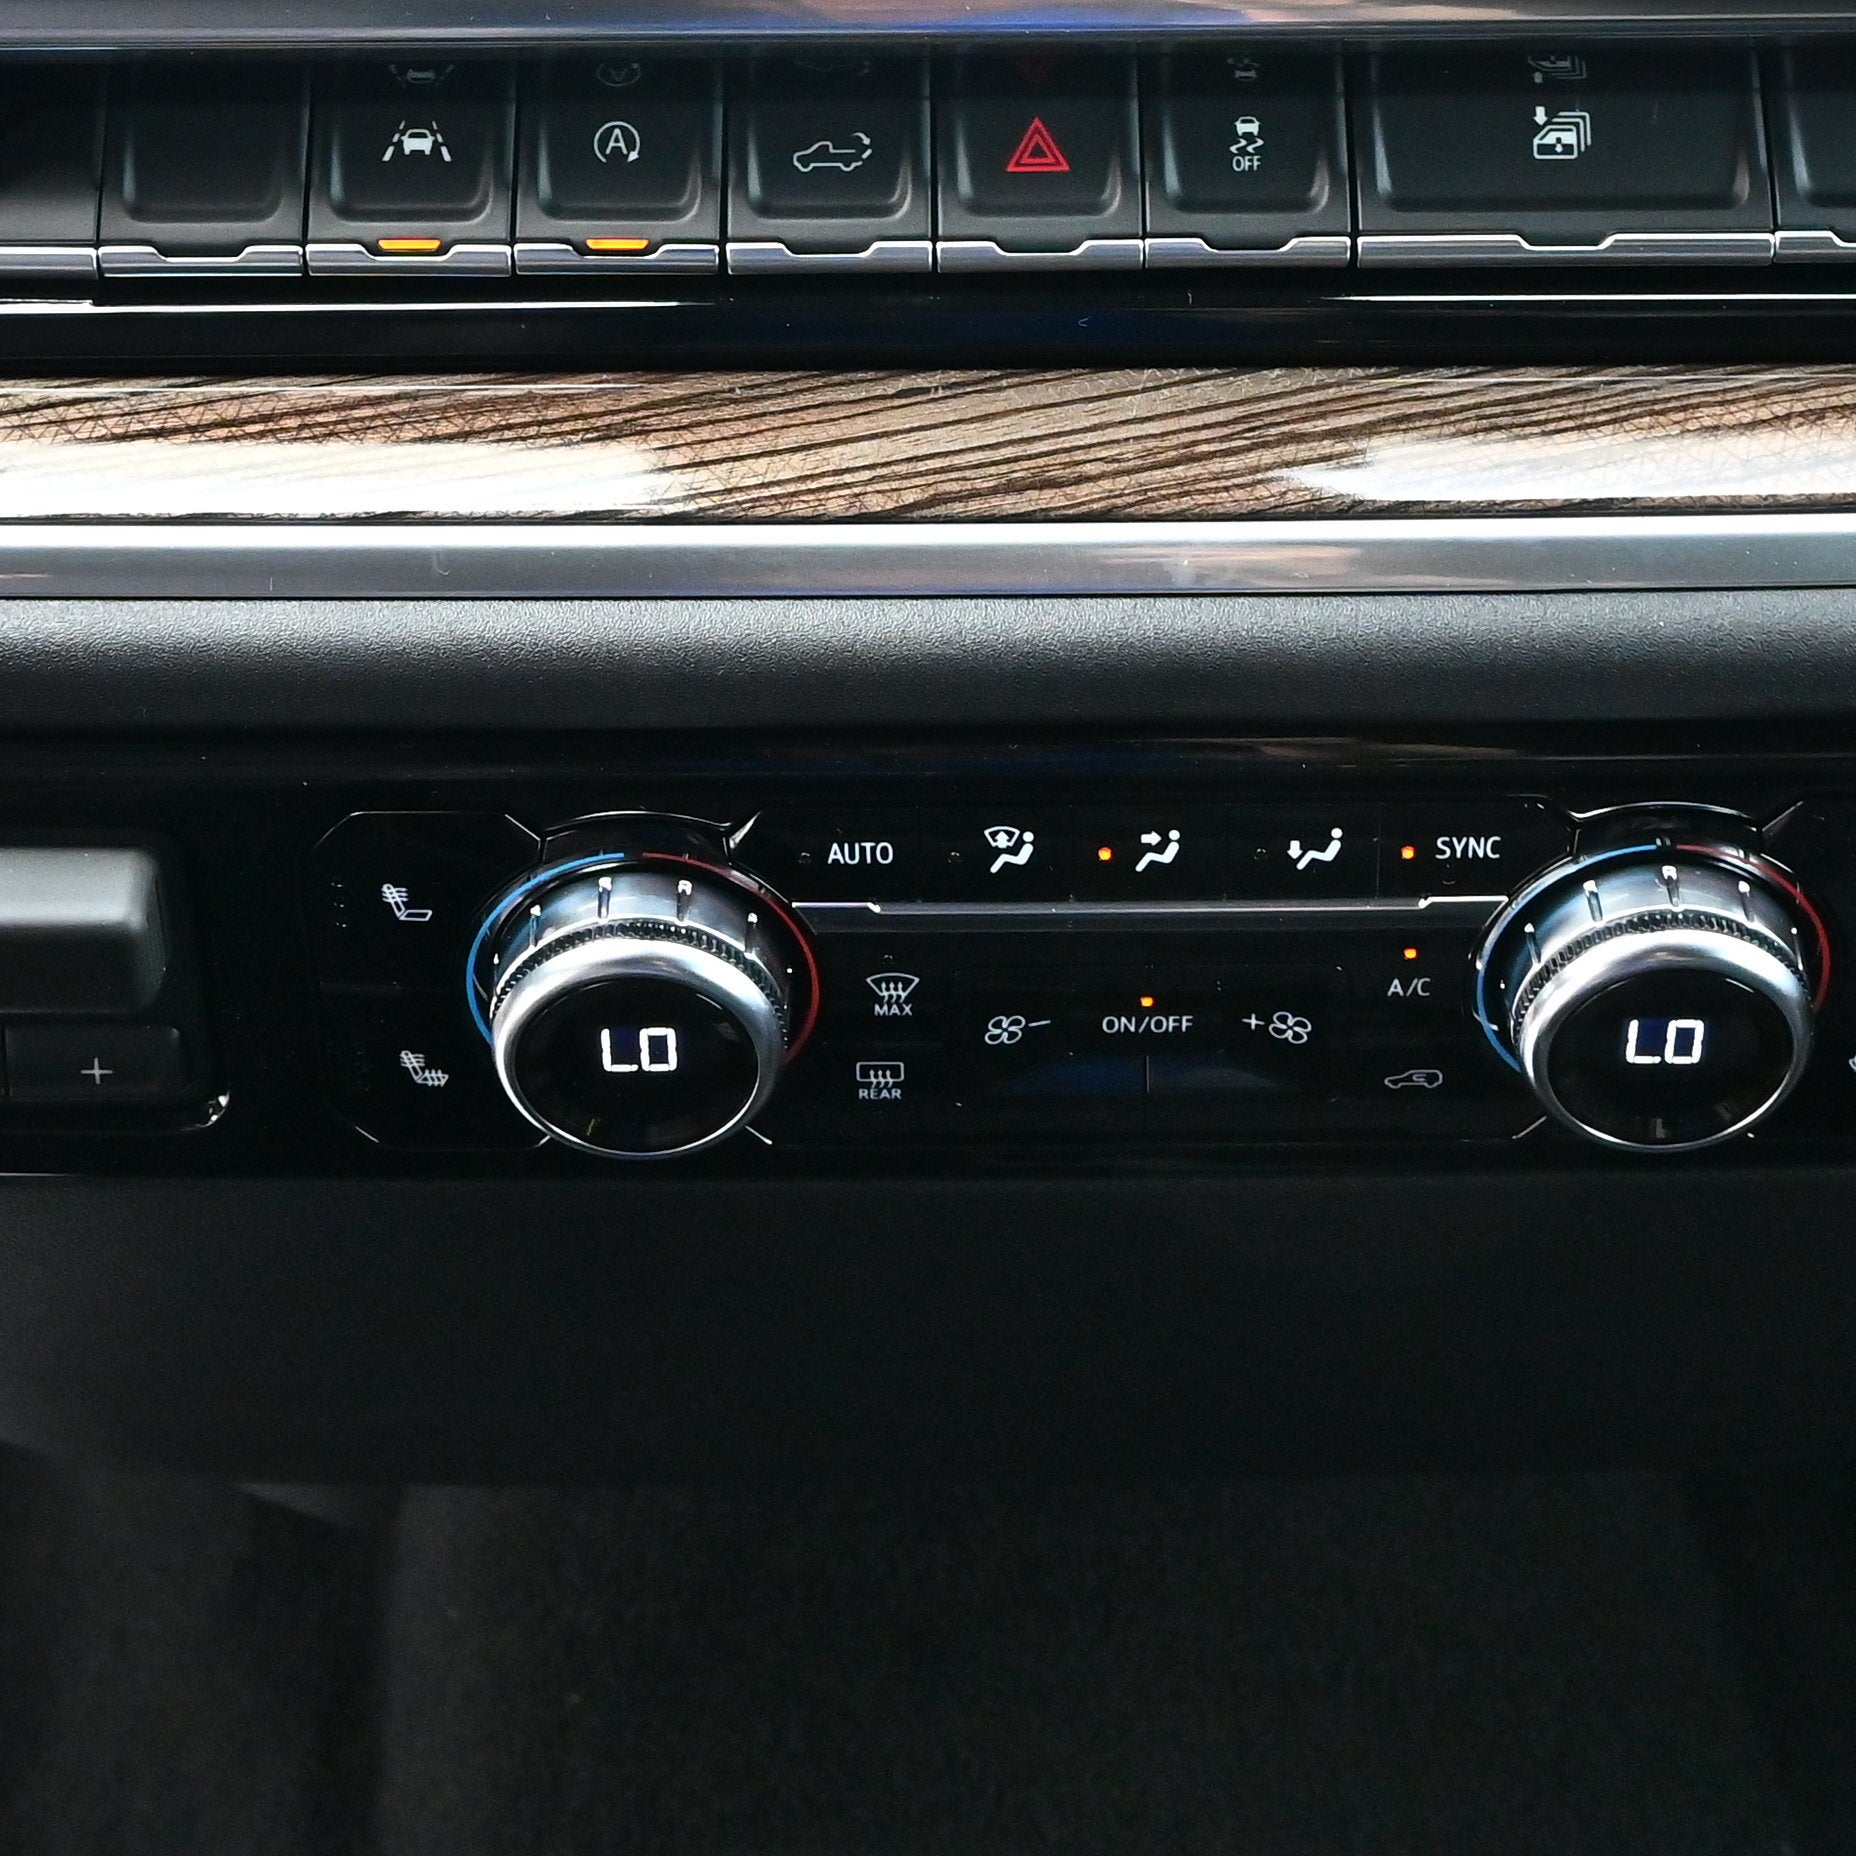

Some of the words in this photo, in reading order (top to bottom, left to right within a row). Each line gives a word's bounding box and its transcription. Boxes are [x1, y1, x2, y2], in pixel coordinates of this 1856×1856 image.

[1231, 154, 1263, 173] OFF
[827, 841, 894, 865] AUTO
[1435, 835, 1501, 860] SYNC
[1387, 977, 1431, 997] A/C
[874, 999, 913, 1016] MAX
[1102, 1015, 1193, 1034] ON/OFF
[600, 1026, 678, 1073] LO
[1625, 1018, 1705, 1065] LO
[858, 1083, 902, 1100] REAR
